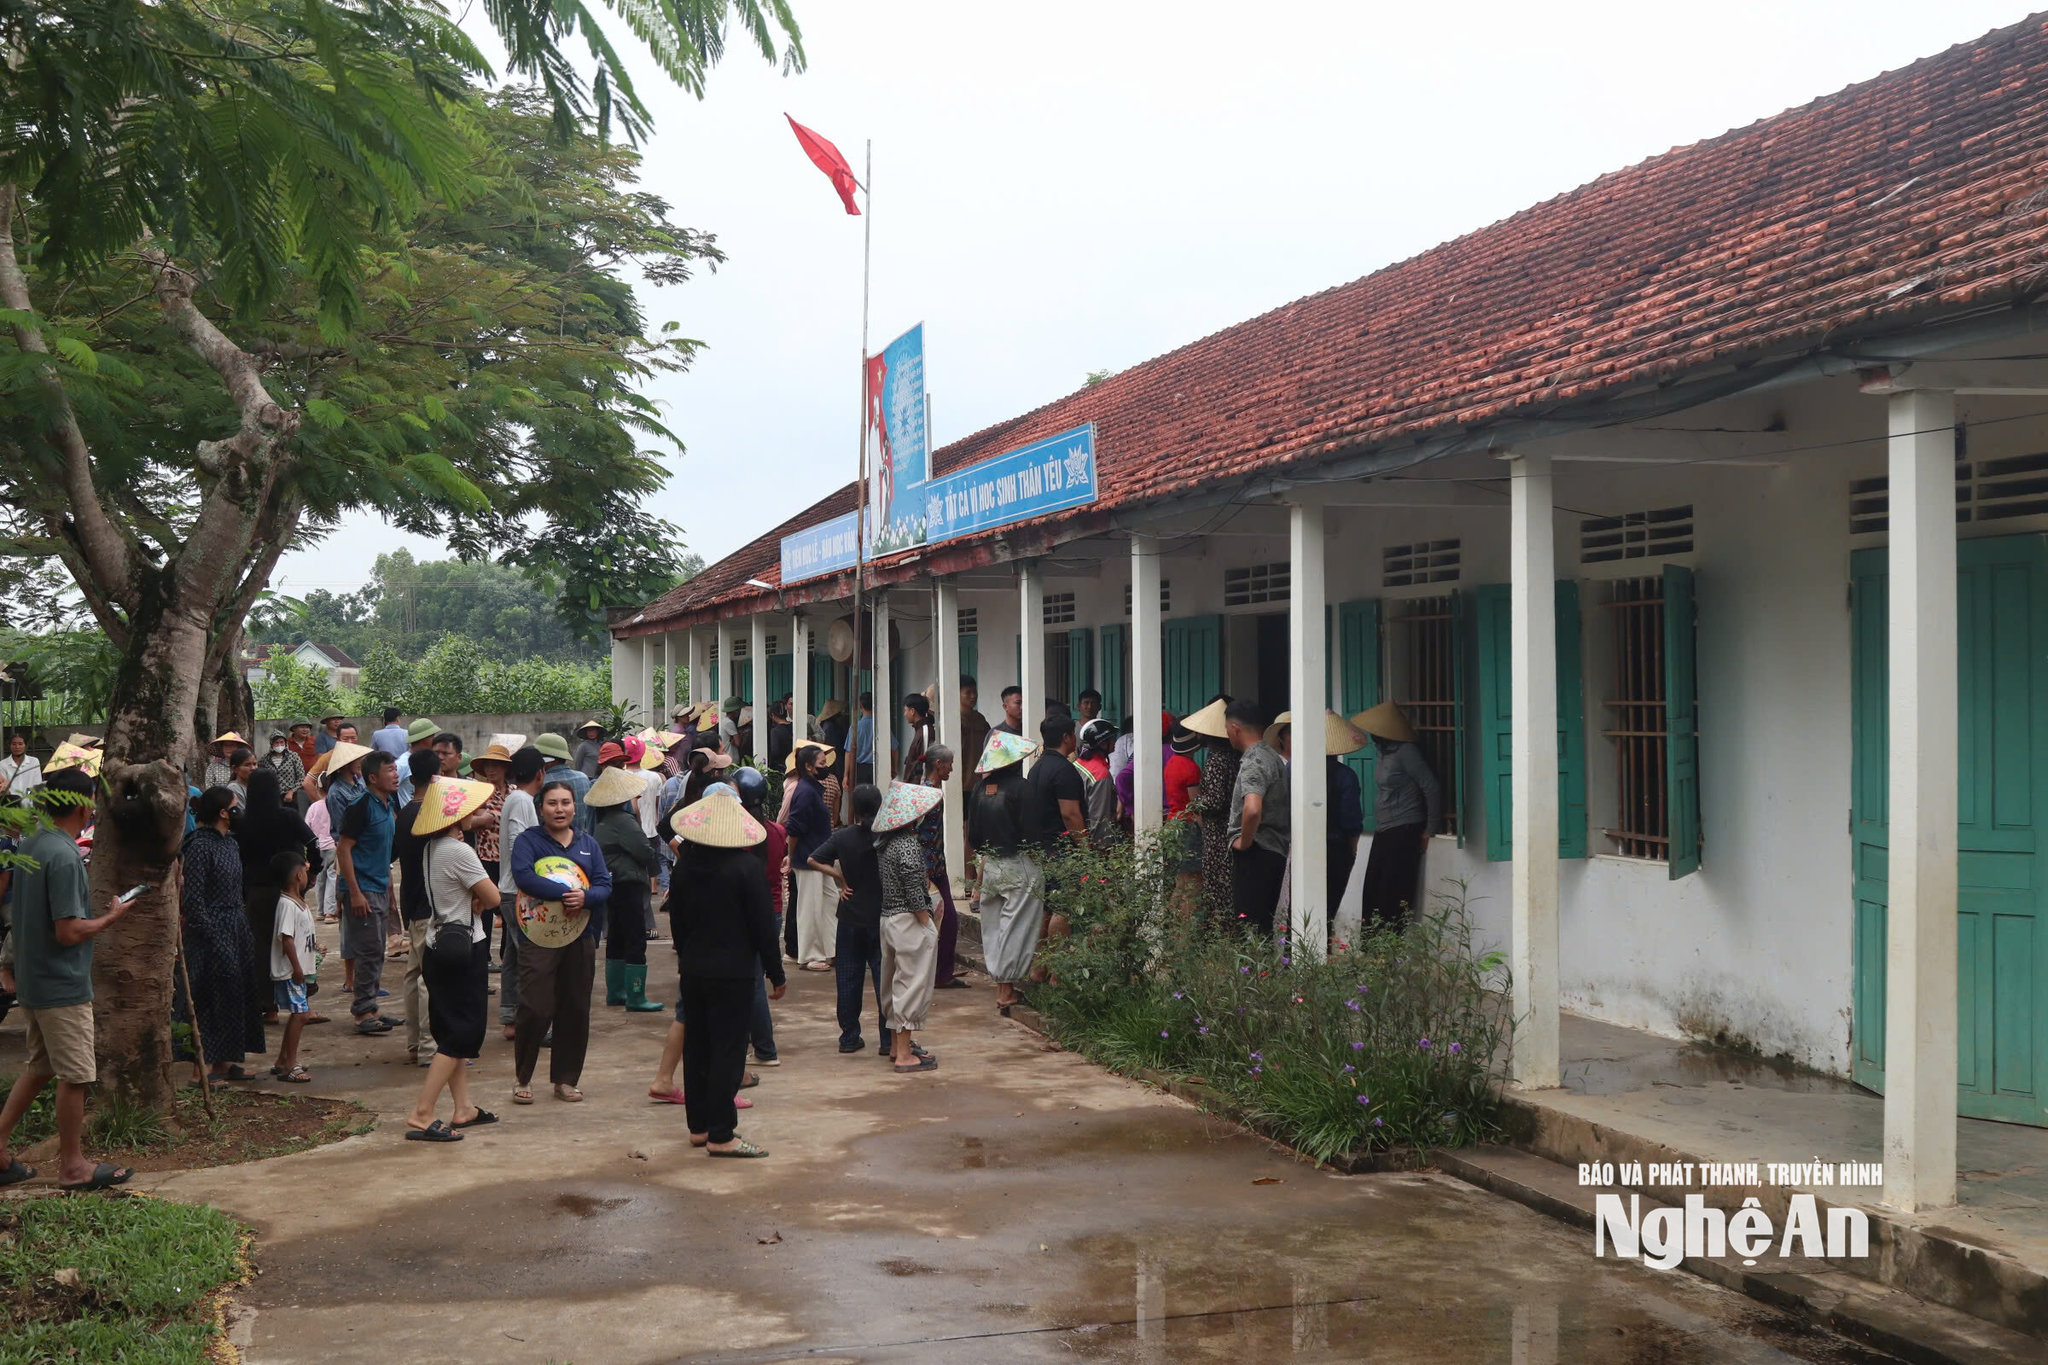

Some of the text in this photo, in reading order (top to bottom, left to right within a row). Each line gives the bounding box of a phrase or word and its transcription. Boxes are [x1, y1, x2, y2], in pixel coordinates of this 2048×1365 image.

[945, 454, 1062, 521] TẤT CẢ VÌ HỌC SINH THÂN YÊU
